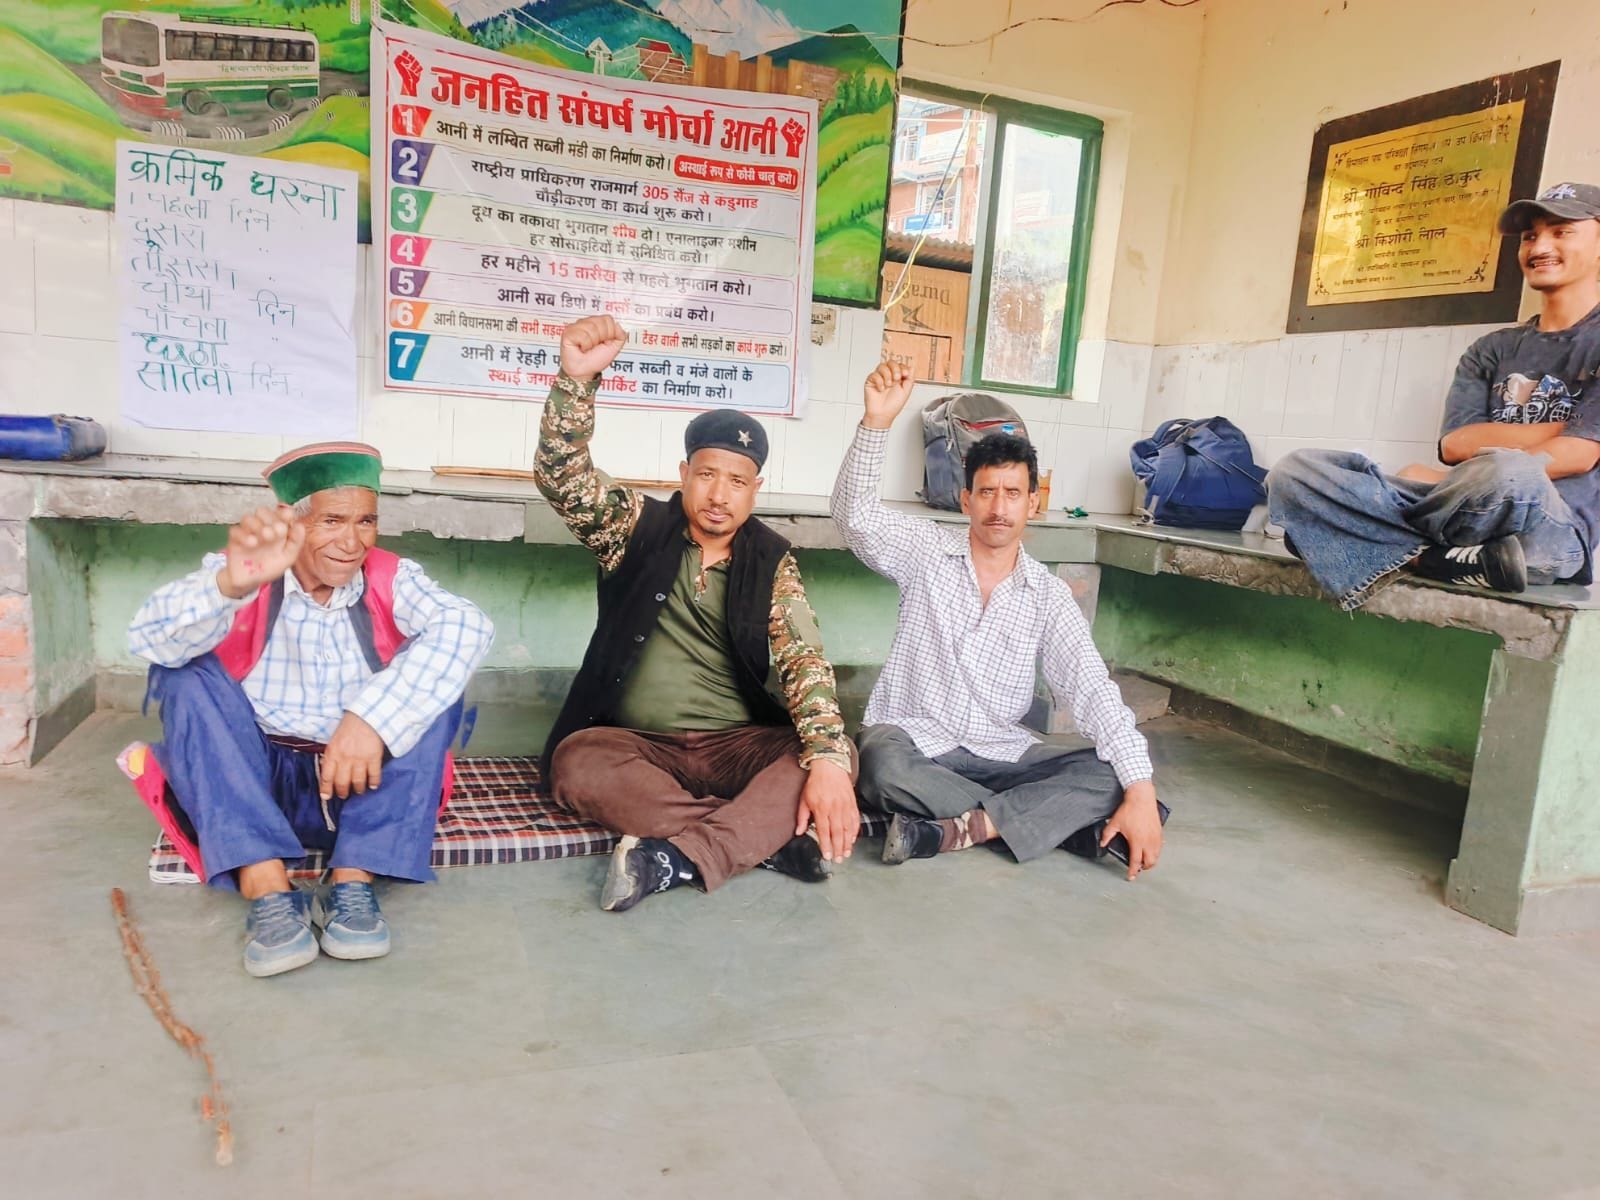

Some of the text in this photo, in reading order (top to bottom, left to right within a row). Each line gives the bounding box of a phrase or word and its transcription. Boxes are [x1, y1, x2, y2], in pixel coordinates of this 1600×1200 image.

[400, 108, 414, 136] 1
[431, 67, 778, 155] जनहित संघर्ष मोर्चा आनी
[436, 120, 467, 140] आनी
[472, 125, 484, 142] में
[488, 128, 529, 150] लम्बित
[533, 136, 565, 155] सब्जी
[568, 139, 589, 159] मंडी
[592, 146, 606, 161] का
[610, 146, 642, 166] निर्माण
[128, 149, 227, 196] क्रमिक
[398, 148, 418, 178] 2
[726, 166, 734, 179] से
[471, 159, 515, 181] राष्ट्रीय
[521, 167, 585, 189] प्राधिकरण
[590, 178, 638, 197] राजमार्ग
[642, 185, 669, 201] 305
[699, 191, 710, 206] से
[1343, 184, 1358, 205] श्री
[1364, 181, 1406, 200] गोविन्द
[1411, 174, 1438, 192] सिंह
[397, 193, 418, 224] 3
[535, 187, 597, 209] चौड़ीकरण
[601, 198, 617, 212] का
[622, 200, 648, 216] कार्य
[654, 205, 676, 221] शुरू
[472, 204, 492, 223] दूध
[497, 209, 514, 223] का
[565, 219, 608, 236] भुगतान
[728, 236, 757, 252] मशीन
[1356, 235, 1370, 249] श्री
[1374, 228, 1413, 247] किशोरी
[397, 238, 415, 262] 4
[530, 233, 545, 247] हर
[550, 232, 612, 256] सोसाइटियों
[617, 242, 626, 257] में
[630, 244, 675, 262] सुनिश्चित
[397, 271, 416, 295] 5
[481, 254, 499, 269] हर
[505, 254, 541, 273] महीने
[549, 261, 569, 278] 15
[576, 263, 617, 284] तारीख
[622, 270, 634, 285] से
[639, 271, 670, 289] पहले
[675, 276, 718, 293] भुगतान
[248, 288, 296, 328] दिन
[397, 302, 414, 327] 6
[498, 287, 529, 304] आनी
[561, 292, 586, 311] डिपो
[591, 296, 600, 312] में
[634, 305, 651, 318] का
[433, 313, 456, 330] आनी
[458, 312, 503, 332] विधानसभा
[506, 318, 518, 334] की
[521, 318, 539, 335] सभी
[661, 331, 680, 348] वाली
[682, 333, 698, 349] सभी
[700, 336, 723, 353] सड़कों
[726, 340, 735, 355] का
[395, 338, 416, 369] 7
[461, 345, 494, 362] आनी
[500, 346, 510, 363] में
[517, 347, 546, 369] रेहड़ी
[610, 360, 633, 373] फल
[639, 359, 671, 376] सब्जी
[676, 364, 685, 377] व
[713, 365, 738, 381] वालों
[742, 366, 753, 383] के
[248, 361, 291, 395] दिन
[488, 367, 521, 386] स्थाई
[642, 380, 658, 395] का
[664, 378, 700, 397] निर्माण
